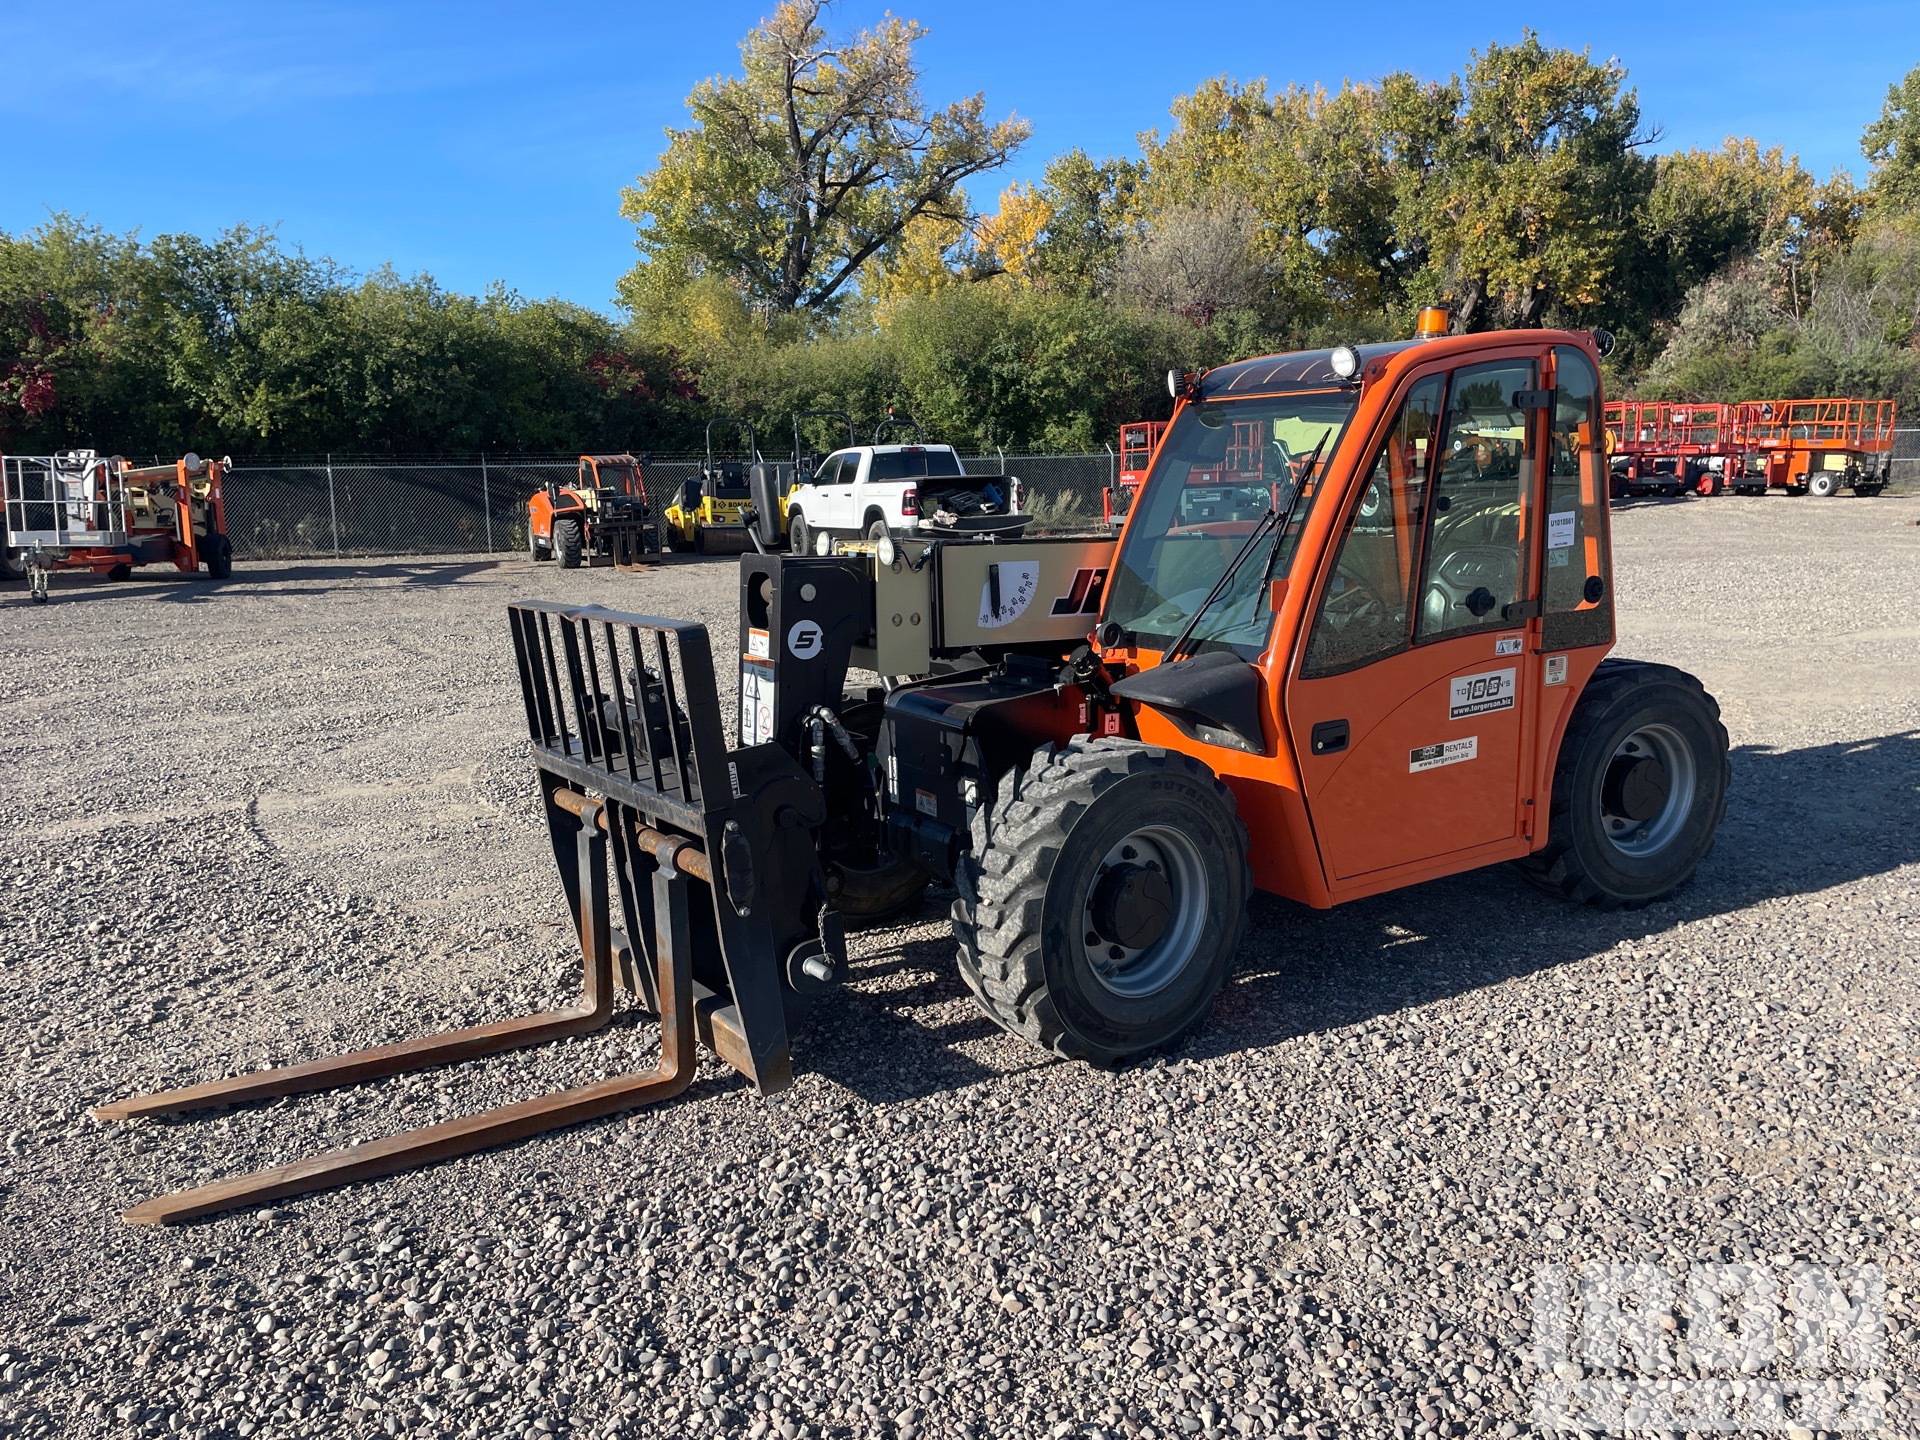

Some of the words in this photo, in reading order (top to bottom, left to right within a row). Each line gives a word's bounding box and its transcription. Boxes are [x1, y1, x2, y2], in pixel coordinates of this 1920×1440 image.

[1021, 572, 1030, 580] 80
[1025, 580, 1033, 589] 70
[1017, 585, 1026, 595] 60
[1011, 597, 1018, 607] 40
[1018, 595, 1027, 605] 50
[1001, 604, 1008, 615] 20
[1008, 606, 1016, 617] 30
[1453, 697, 1512, 715] www.torgerson.biz
[1445, 740, 1473, 754] RENTALS
